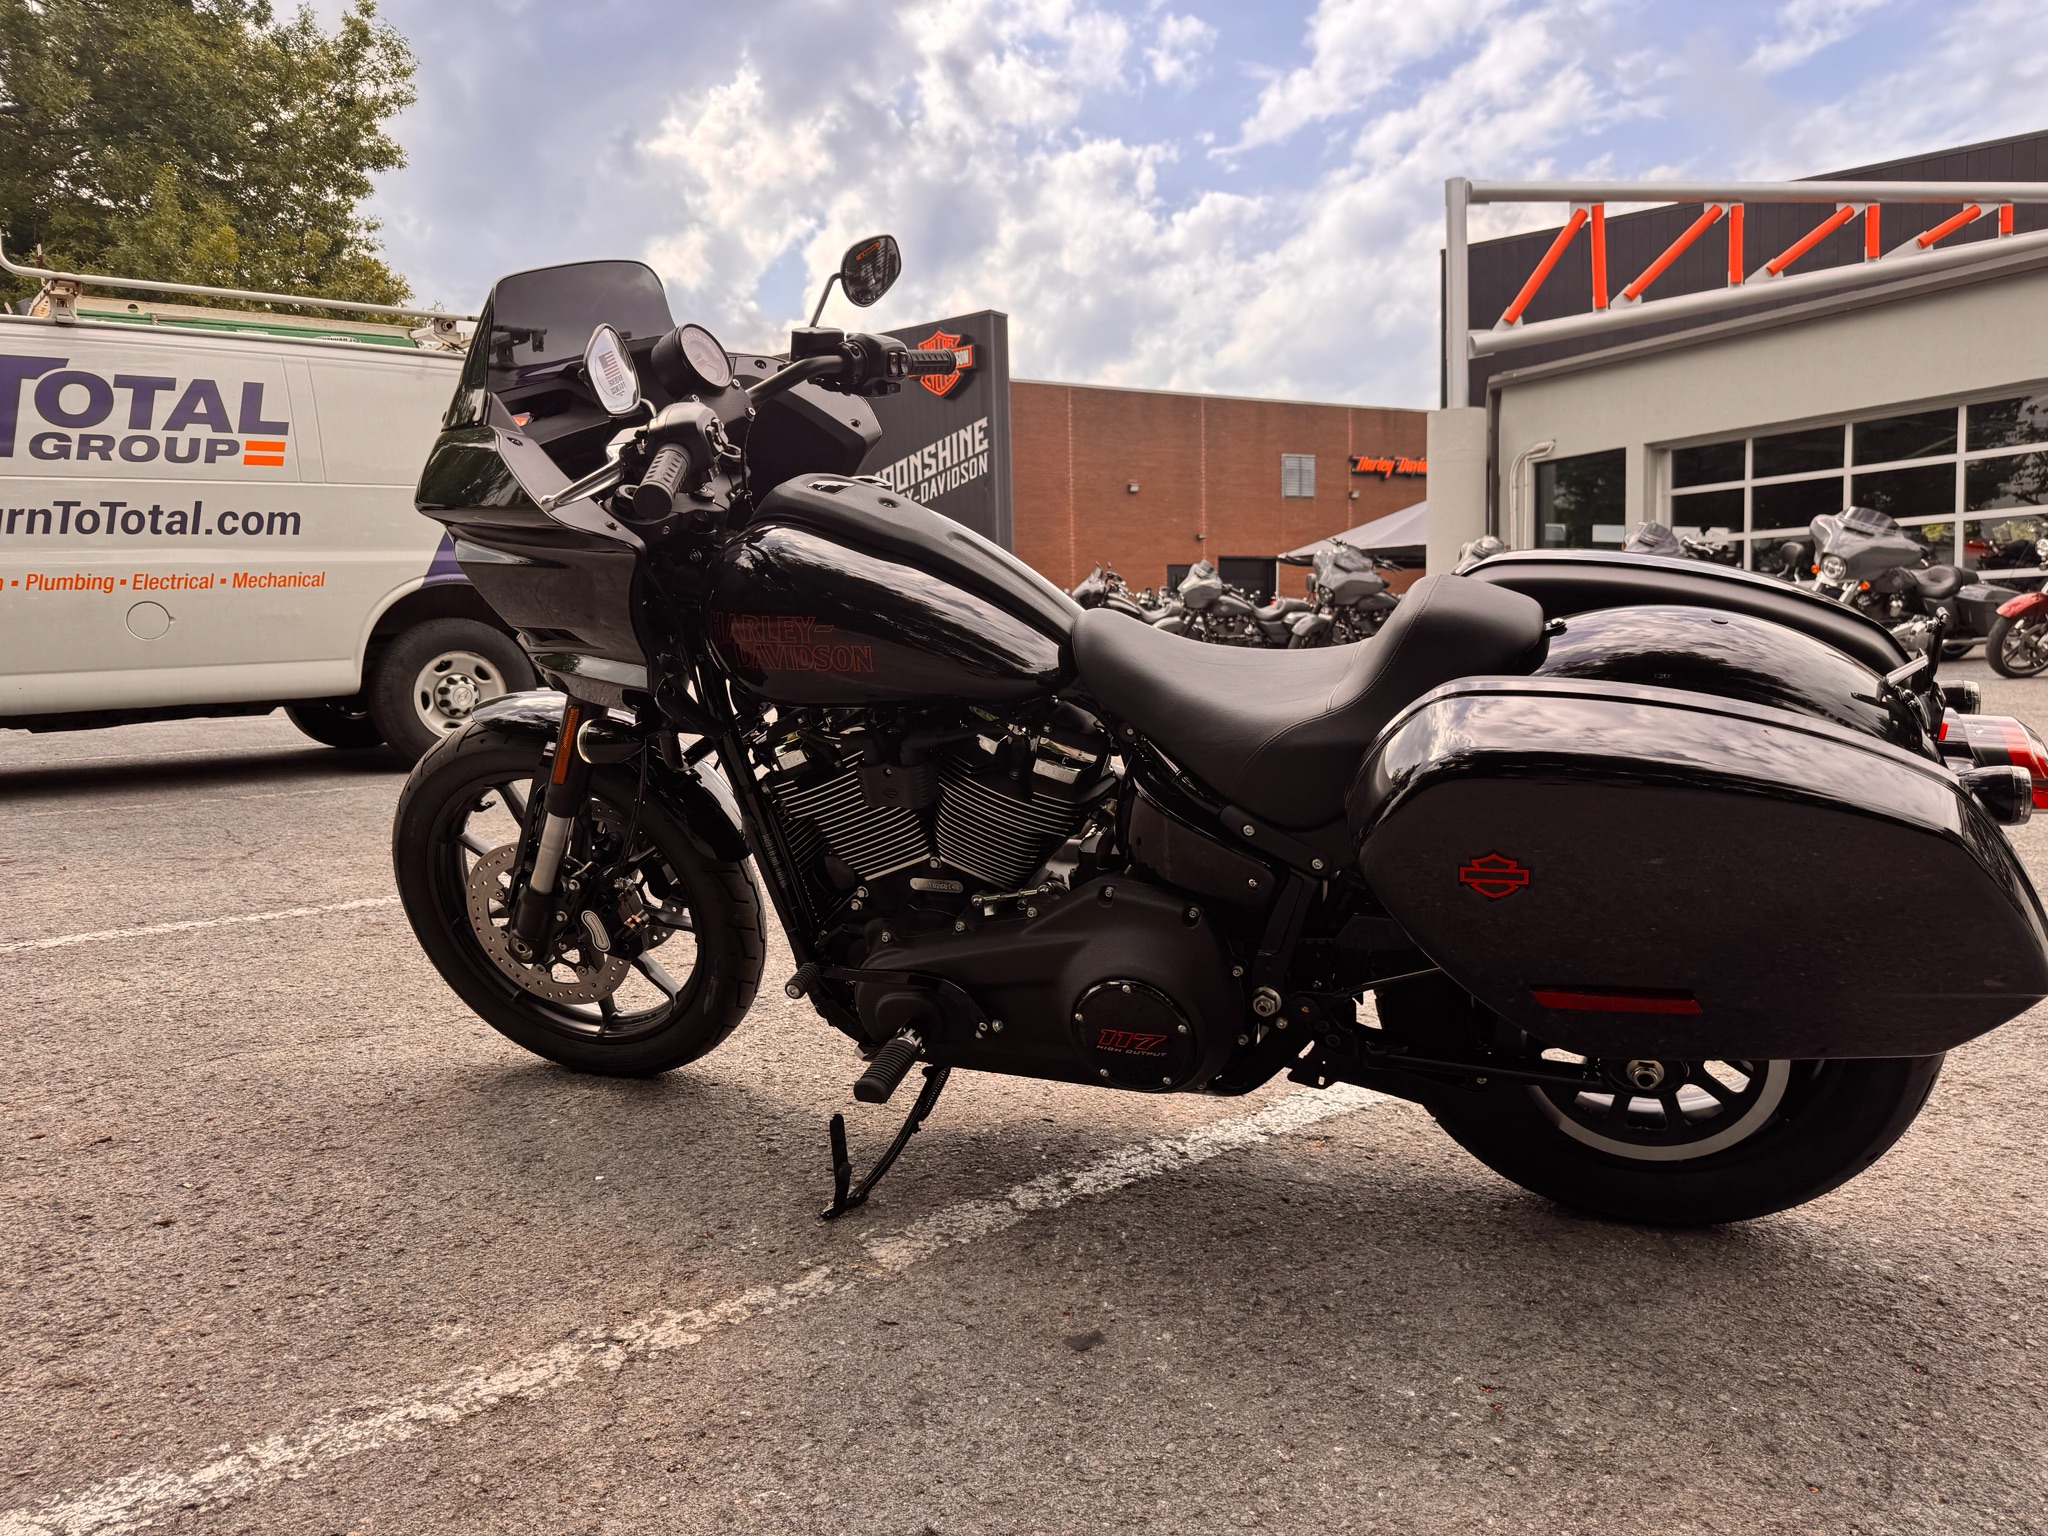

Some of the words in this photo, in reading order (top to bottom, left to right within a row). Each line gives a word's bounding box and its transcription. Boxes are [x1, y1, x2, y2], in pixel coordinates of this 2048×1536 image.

[0, 354, 290, 458] TOTAL
[28, 431, 240, 464] GROUP
[874, 416, 989, 494] OONSHINE
[898, 452, 989, 504] Y-DAVIDSON
[1353, 456, 1395, 478] Harley
[0, 500, 301, 535] rnToTotal.com
[25, 573, 115, 594] Plumbing
[132, 572, 215, 591] Electrical
[231, 571, 326, 589] Mechanical
[734, 643, 874, 672] DAVIDSON
[1096, 1044, 1122, 1053] HIGH
[1125, 1049, 1168, 1057] OUTPUT
[1098, 1028, 1168, 1051] 117
